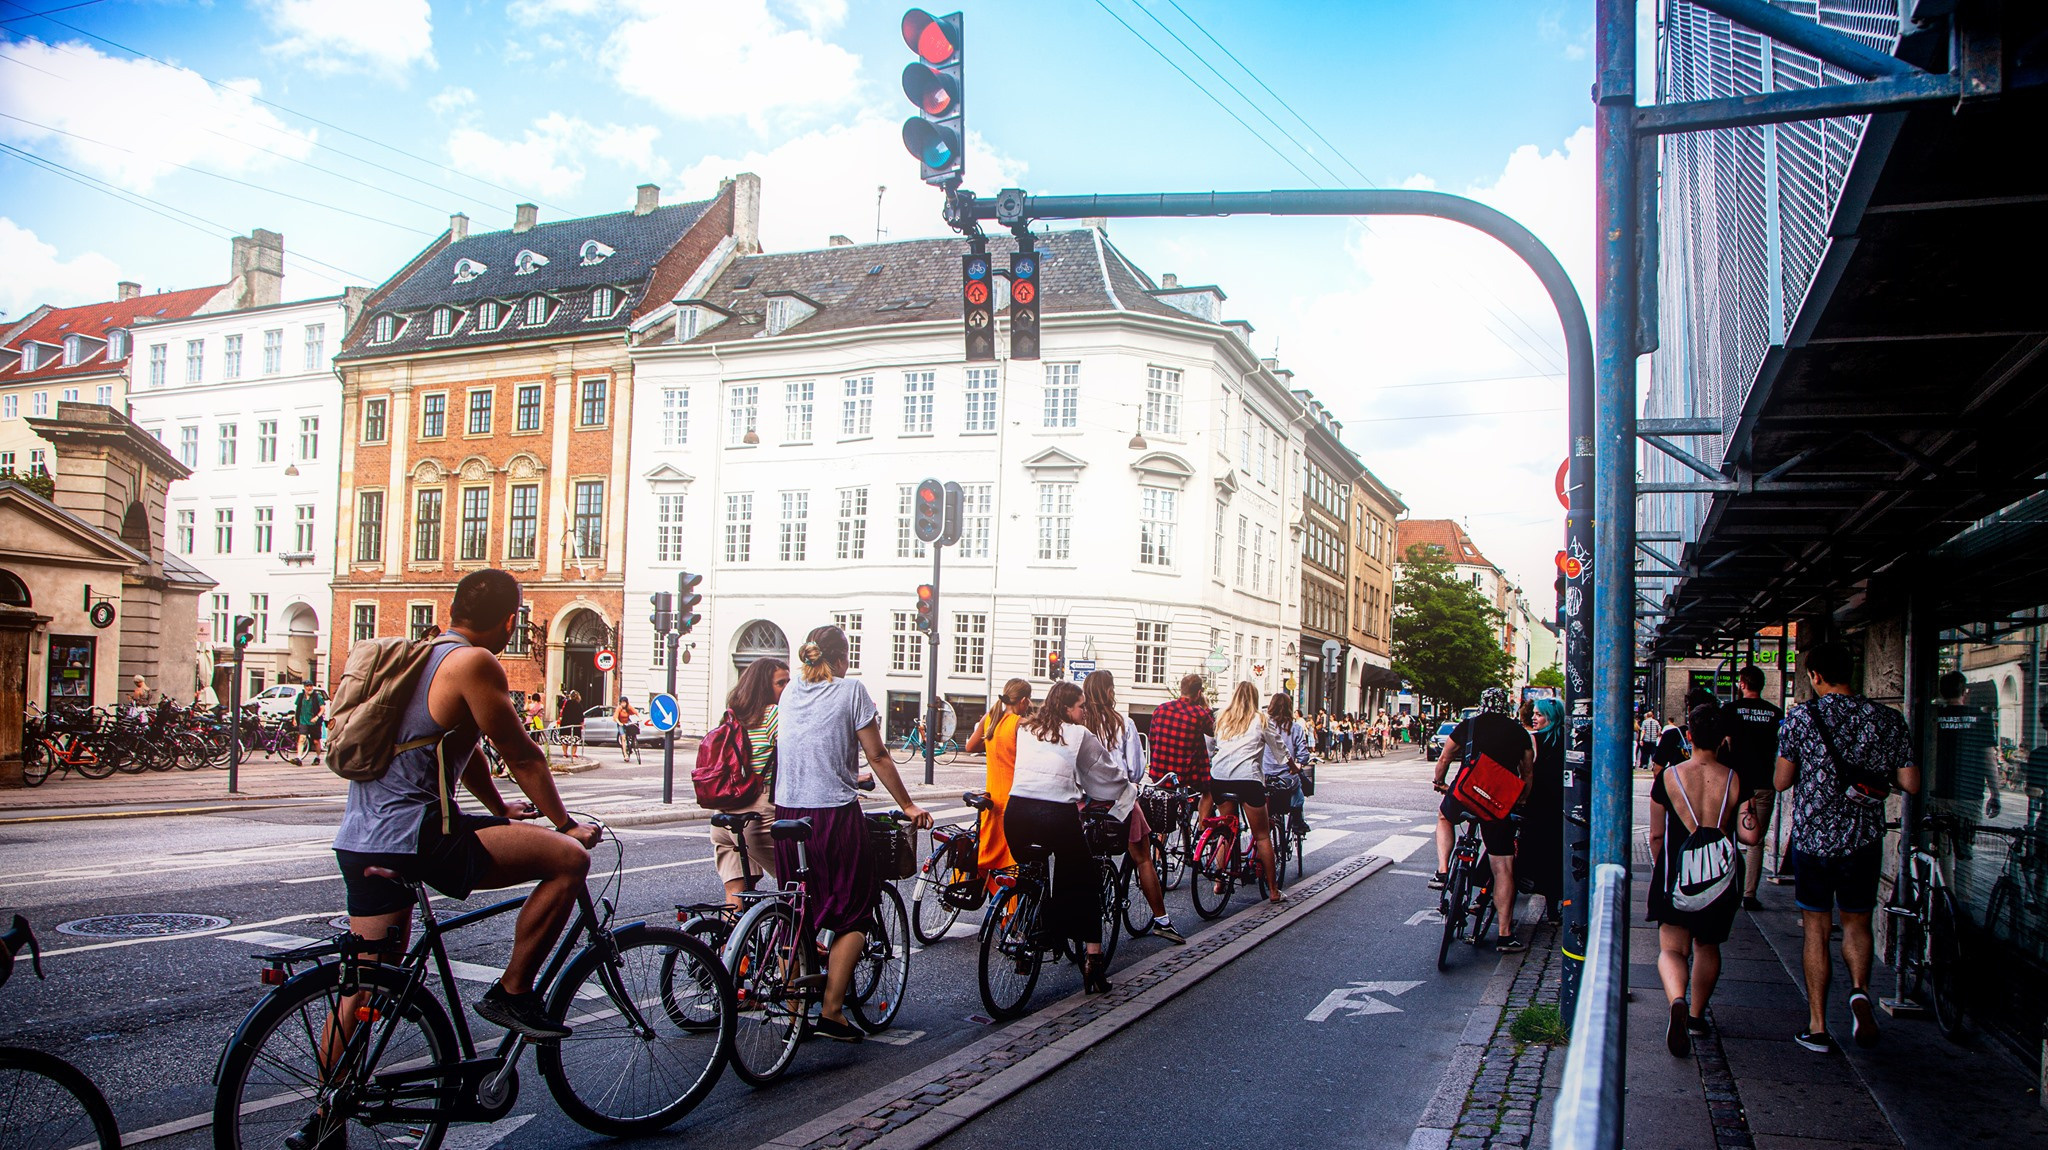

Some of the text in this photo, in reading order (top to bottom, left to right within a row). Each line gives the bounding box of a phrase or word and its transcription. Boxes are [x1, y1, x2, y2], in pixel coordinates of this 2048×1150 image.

[1736, 707, 1775, 718] NEW ZEALAND
[1743, 714, 1770, 723] WHANAU
